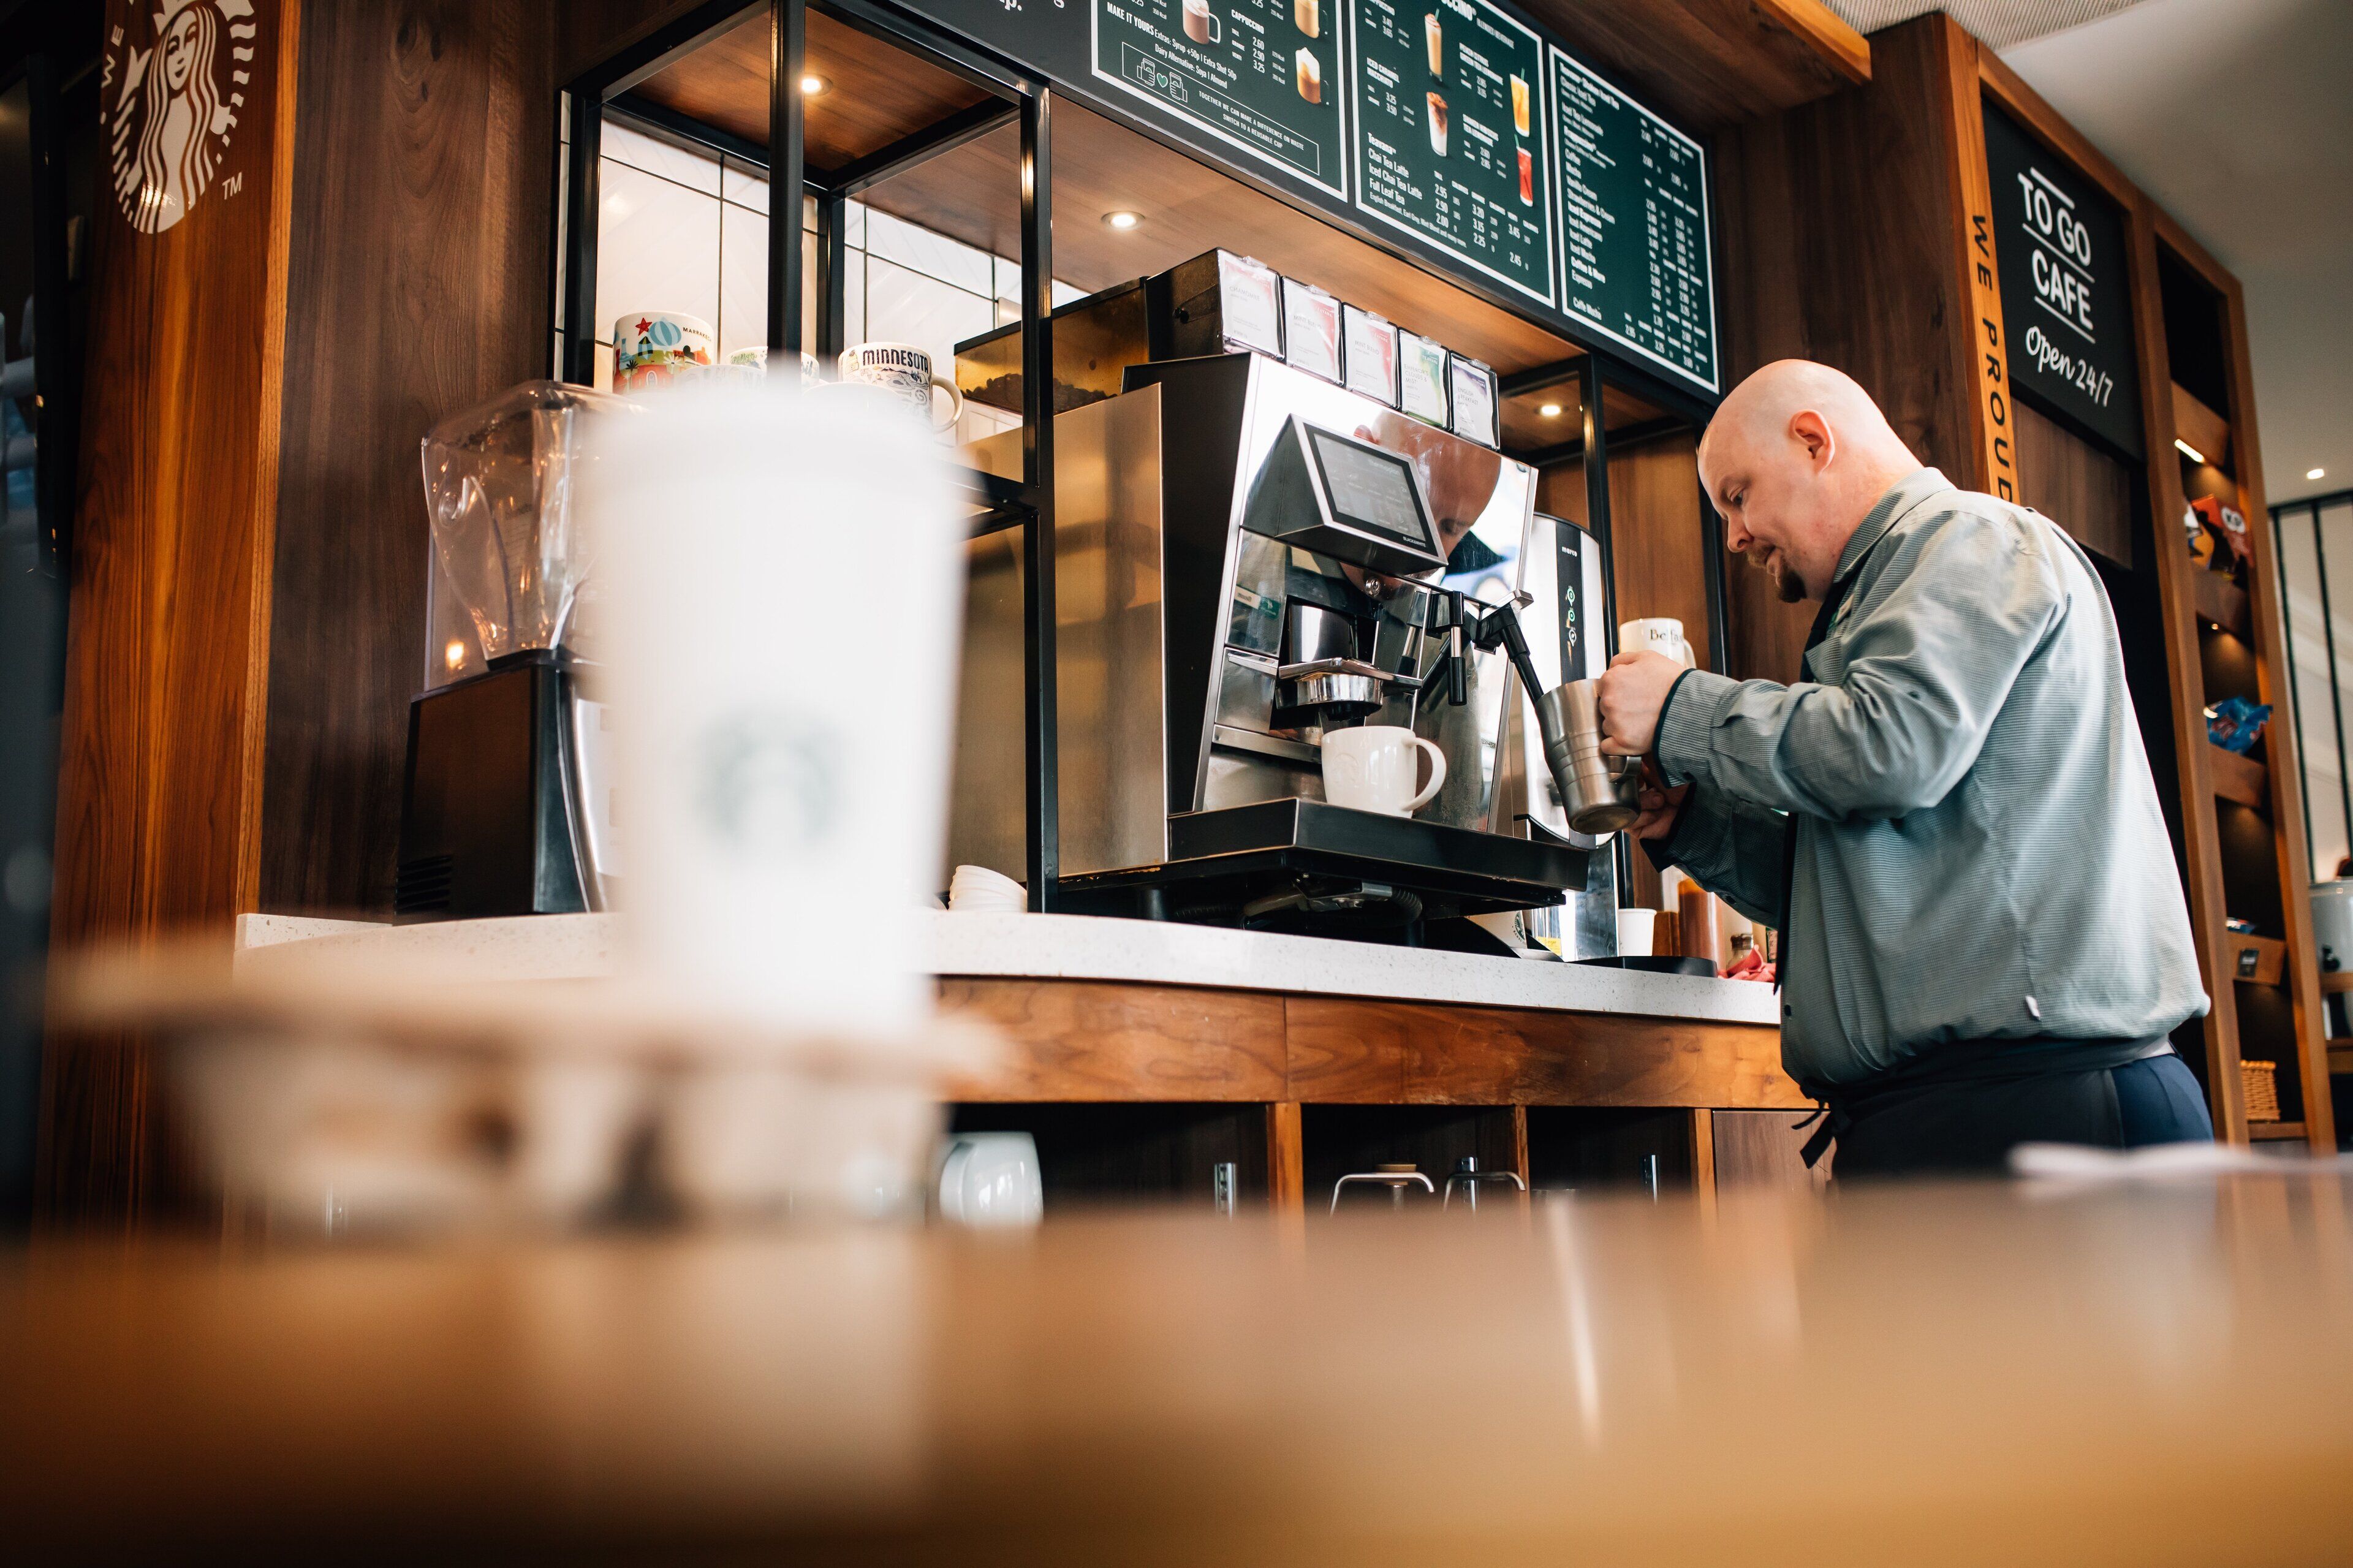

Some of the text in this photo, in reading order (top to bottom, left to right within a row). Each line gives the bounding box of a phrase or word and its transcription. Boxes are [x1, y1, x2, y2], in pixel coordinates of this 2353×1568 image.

[1107, 1, 1125, 20] MAKE
[1126, 12, 1133, 24] IT
[1133, 15, 1154, 36] YOURS
[1154, 28, 1172, 45] Extras:
[1172, 38, 1186, 54] Syrup
[1203, 55, 1216, 69] Extra
[1227, 68, 1237, 81] 50p
[1231, 9, 1265, 34] CAPPUCCINO
[1154, 43, 1168, 59] Dairy
[1168, 50, 1195, 72] Alternative:
[1195, 64, 1207, 78] Soya
[1252, 48, 1265, 62] 2.90
[1252, 59, 1265, 74] 3.25
[1199, 90, 1222, 108] TOGETHER
[1222, 102, 1230, 112] WE
[1230, 107, 1240, 117] CAN
[1240, 112, 1252, 124] MAKE
[1256, 121, 1283, 140] DIFFERENCE
[1290, 138, 1305, 151] WASTE
[1222, 113, 1240, 127] SWITCH
[1240, 122, 1247, 131] TO
[1251, 127, 1273, 145] REUSABLE
[1273, 139, 1283, 149] CUP
[1368, 147, 1382, 164] Chai
[1382, 154, 1393, 170] Tea
[1393, 161, 1409, 178] Latte
[1434, 183, 1448, 199] 2.95
[1368, 162, 1382, 178] Iced
[1382, 169, 1396, 186] Chai
[1395, 176, 1407, 192] Tea
[1407, 183, 1423, 200] Latte
[1435, 197, 1449, 214] 2.90
[1369, 177, 1381, 193] Full
[1381, 183, 1395, 200] Leaf
[1394, 190, 1405, 205] Tea
[2017, 172, 2092, 267] TO GO
[2031, 248, 2094, 331] CAFE
[862, 348, 929, 374] MINNESOTA
[1972, 213, 2014, 503] WE PROUD
[2025, 324, 2113, 407] Open 24/7
[1561, 545, 1578, 558] marco
